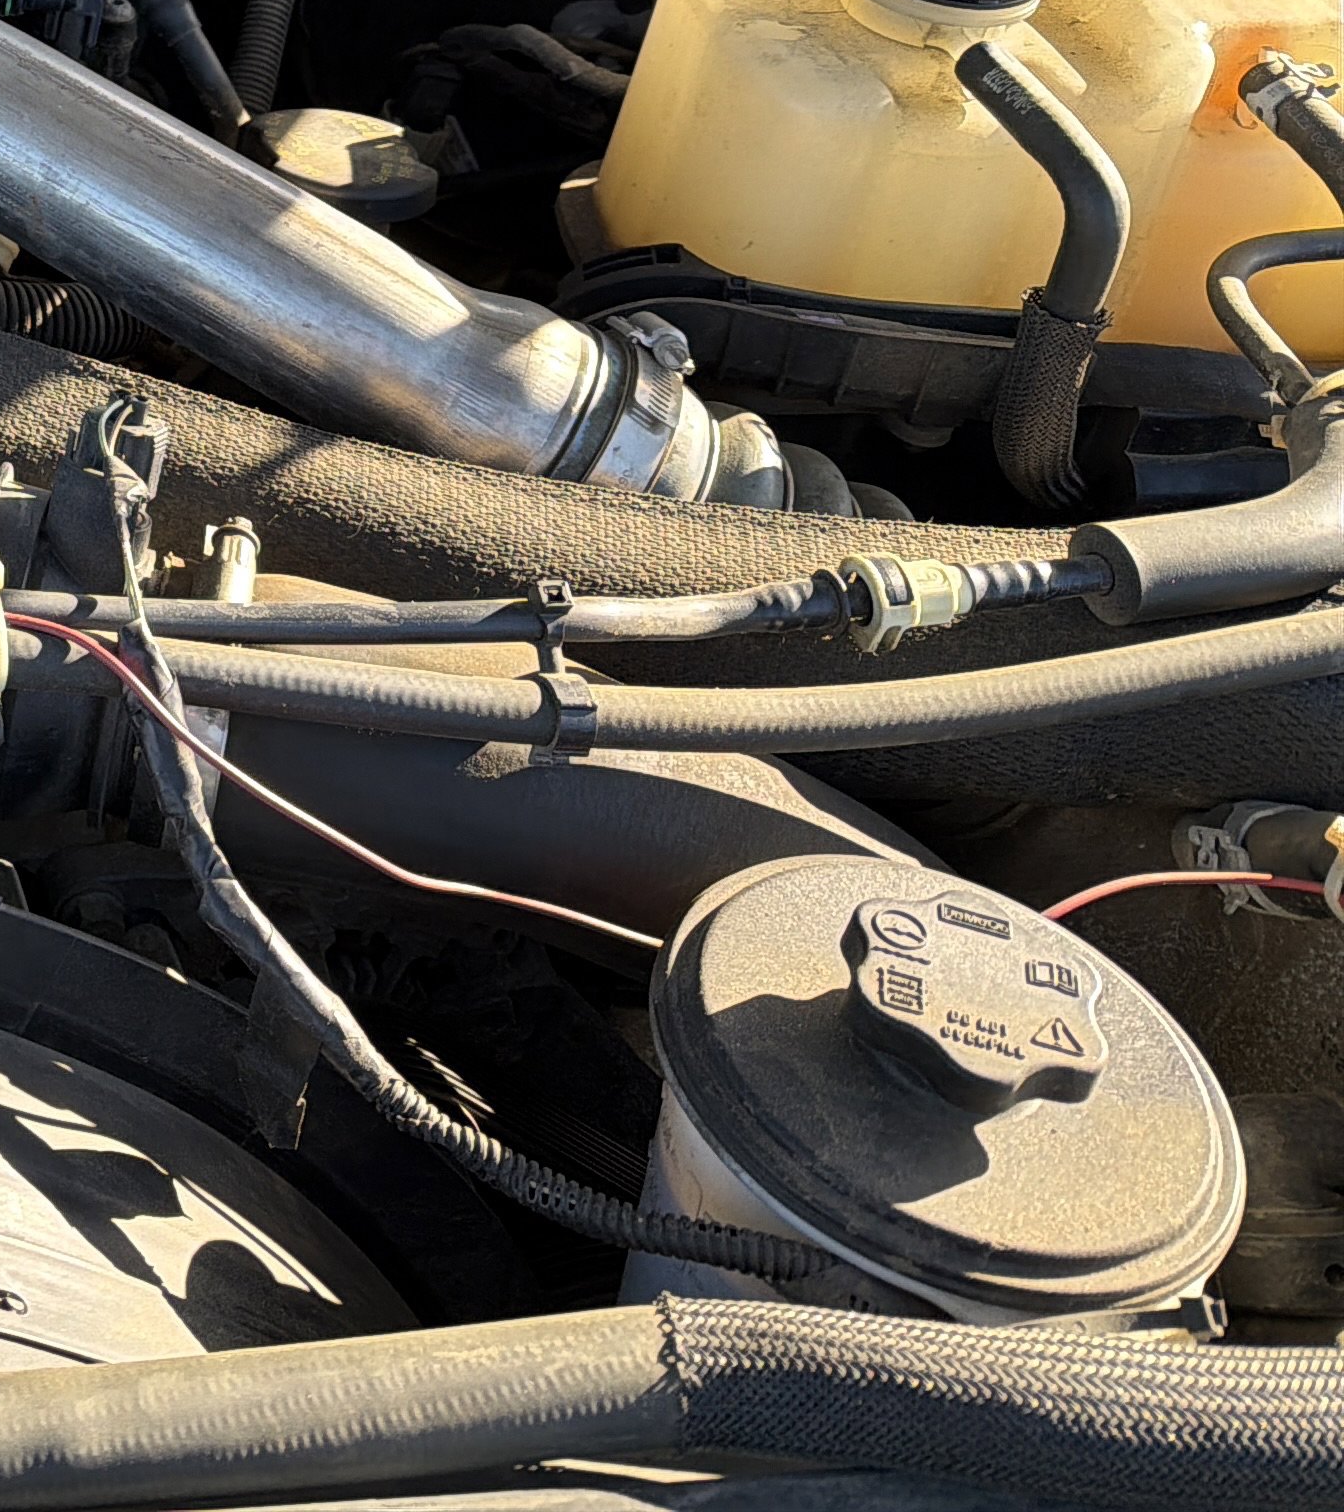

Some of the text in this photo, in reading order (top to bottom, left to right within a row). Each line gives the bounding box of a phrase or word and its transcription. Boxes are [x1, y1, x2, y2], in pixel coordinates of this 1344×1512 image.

[946, 1009, 1009, 1039] DO NOT
[938, 1025, 1026, 1061] OVERFILL
